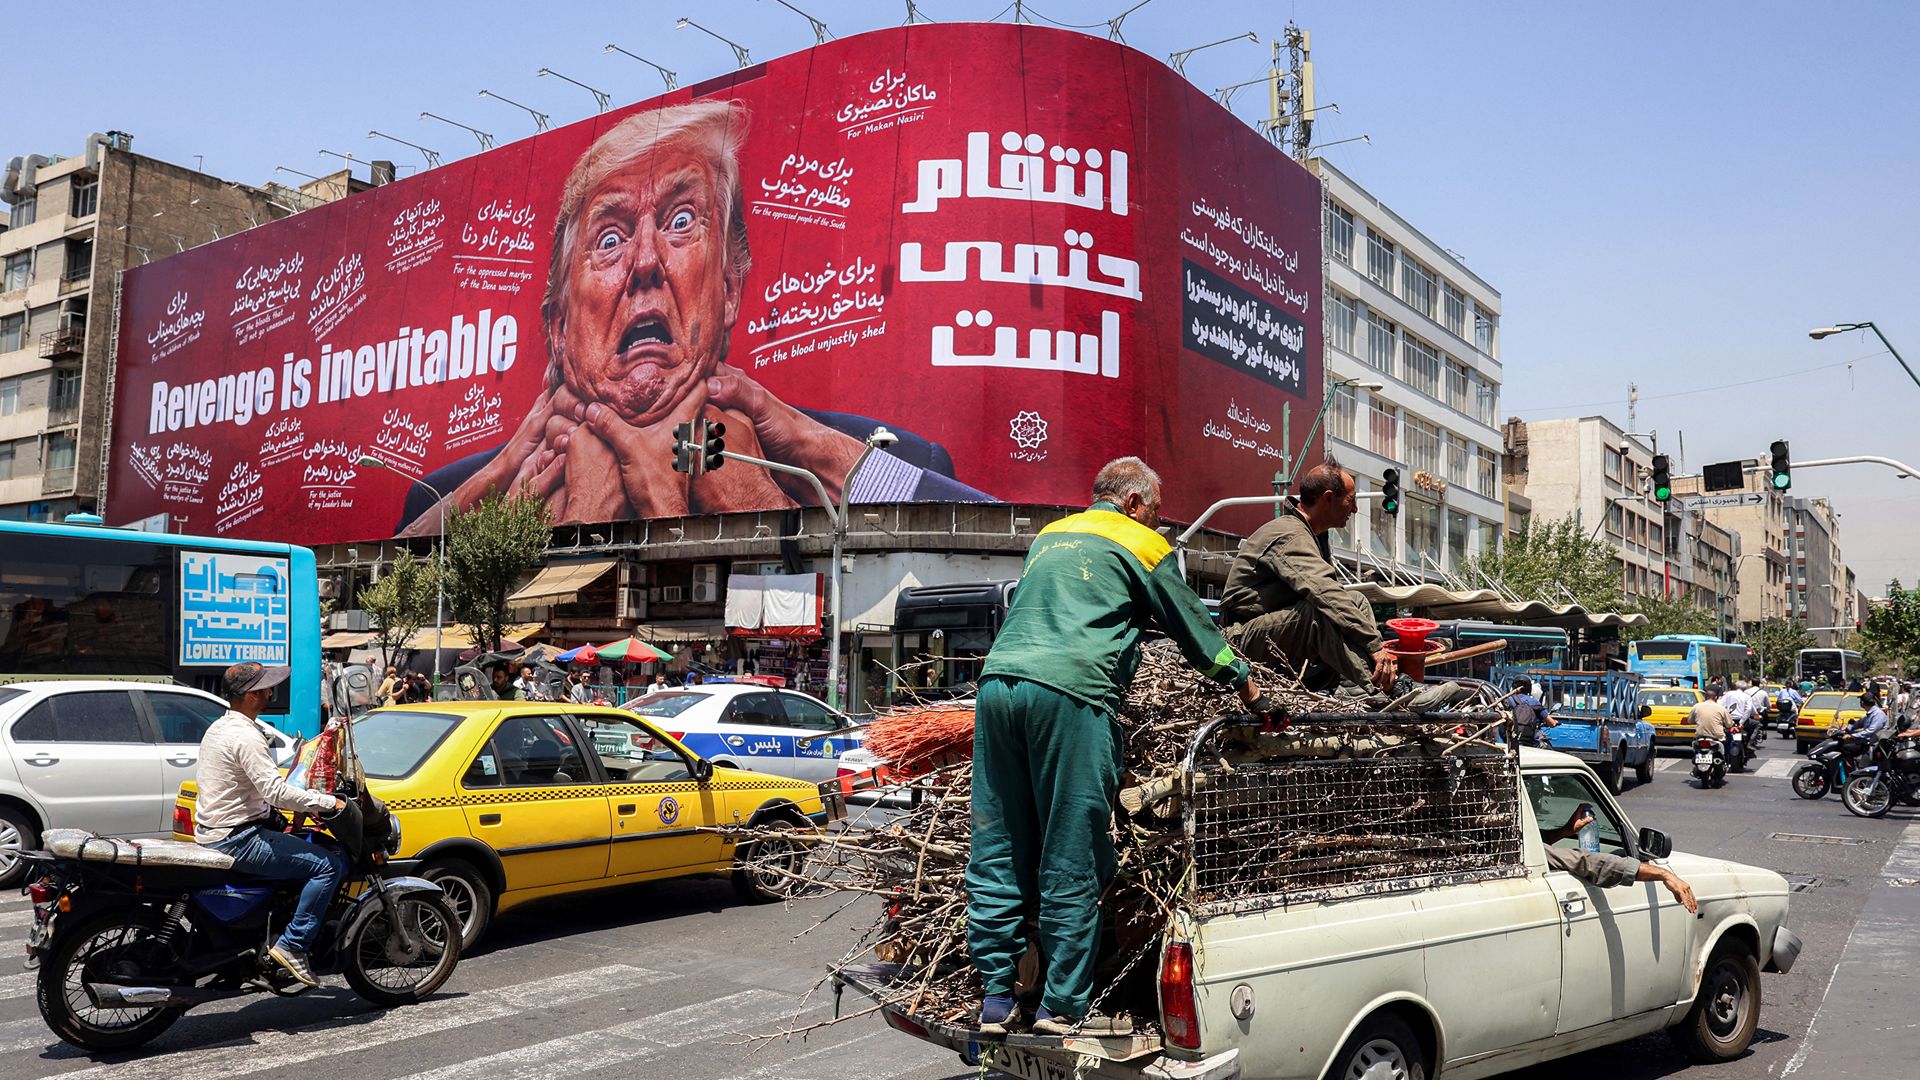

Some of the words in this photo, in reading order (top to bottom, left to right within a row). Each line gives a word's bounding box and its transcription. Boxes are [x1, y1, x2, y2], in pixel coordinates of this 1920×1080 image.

[870, 69, 906, 93] برای
[837, 92, 893, 122] نصیری
[895, 84, 936, 108] ماکان
[847, 129, 861, 140] For
[865, 122, 894, 135] Makan
[897, 112, 924, 125] Nasiri
[780, 154, 818, 175] مردم
[819, 158, 854, 185] برای
[902, 132, 1128, 216] انتقام
[762, 178, 807, 202] جنوب
[805, 184, 850, 208] مظلوم
[394, 210, 406, 226] که
[422, 198, 440, 216] برای
[478, 200, 512, 222] شهدای
[512, 204, 536, 228] برای
[752, 206, 762, 214] For
[762, 208, 771, 216] the
[772, 211, 797, 220] oppressed
[798, 214, 812, 224] people
[813, 216, 820, 225] of
[820, 218, 829, 226] the
[829, 220, 846, 230] South
[1192, 197, 1231, 230] فهرستی
[417, 218, 436, 235] محل
[435, 214, 445, 227] در
[1231, 217, 1242, 235] که
[414, 229, 436, 248] شهید
[462, 222, 478, 244] دنا
[478, 226, 498, 251] ناو
[498, 232, 534, 255] مظلوم
[1242, 222, 1285, 265] جنایتکاران
[392, 238, 414, 256] شدند
[1209, 242, 1241, 273] موجود
[287, 251, 304, 274] برای
[346, 253, 361, 274] برای
[453, 262, 464, 274] For
[466, 265, 476, 275] the
[478, 268, 508, 279] oppressed
[509, 270, 532, 282] martyrs
[838, 256, 875, 286] برای
[900, 228, 1142, 302] حتمی
[1284, 251, 1298, 272] این
[236, 266, 253, 289] که
[323, 256, 345, 292] آنان
[353, 267, 365, 291] زیر
[460, 278, 469, 288] of
[470, 279, 480, 288] the
[482, 280, 496, 290] Dena
[1187, 269, 1195, 301] را
[1278, 275, 1285, 296] تا
[311, 275, 324, 301] که
[336, 273, 352, 304] آوار
[1195, 279, 1221, 314] بستر
[1284, 288, 1302, 304] صدر
[167, 291, 187, 315] برای
[307, 295, 334, 325] ماندند
[1220, 295, 1232, 316] در
[1232, 300, 1239, 322] و
[1302, 290, 1308, 314] از
[1239, 300, 1257, 330] آرام
[1257, 310, 1280, 340] مرگی
[148, 320, 173, 347] میناب
[1192, 317, 1208, 347] برد
[1209, 326, 1247, 360] خواهند
[1280, 324, 1303, 353] آرزوی
[754, 355, 770, 369] For
[772, 349, 787, 363] the
[791, 339, 815, 358] blood
[818, 330, 858, 351] unjustly
[862, 321, 886, 339] shed
[932, 310, 1120, 378] است
[1246, 342, 1263, 368] گور
[149, 365, 274, 434] Revenge
[281, 352, 311, 410] is
[318, 308, 518, 403] inevitable
[1263, 350, 1274, 375] به
[1274, 356, 1292, 381] خود
[1292, 360, 1299, 388] با
[464, 383, 485, 402] برای
[482, 392, 502, 412] زهرا
[383, 408, 414, 431] مادران
[448, 398, 481, 424] کوچولو
[471, 412, 500, 429] چهارده
[288, 417, 301, 431] برای
[414, 421, 432, 443] برای
[448, 420, 470, 435] ماهه
[1249, 416, 1271, 433] حضرت
[303, 439, 348, 460] دادخواهی
[376, 428, 401, 448] ایران
[398, 436, 426, 458] داغدار
[1232, 434, 1257, 450] حسینی
[167, 442, 199, 460] دادخواهی
[199, 450, 213, 468] برای
[1257, 444, 1278, 459] مجتبی
[185, 465, 209, 483] شهدای
[230, 462, 248, 480] برای
[303, 465, 332, 482] رهبرم
[334, 465, 357, 485] خون
[308, 500, 314, 509] of
[309, 490, 318, 499] For
[186, 643, 232, 660] LOVELY
[234, 644, 284, 660] TEHRAN
[748, 736, 781, 755] پلیس
